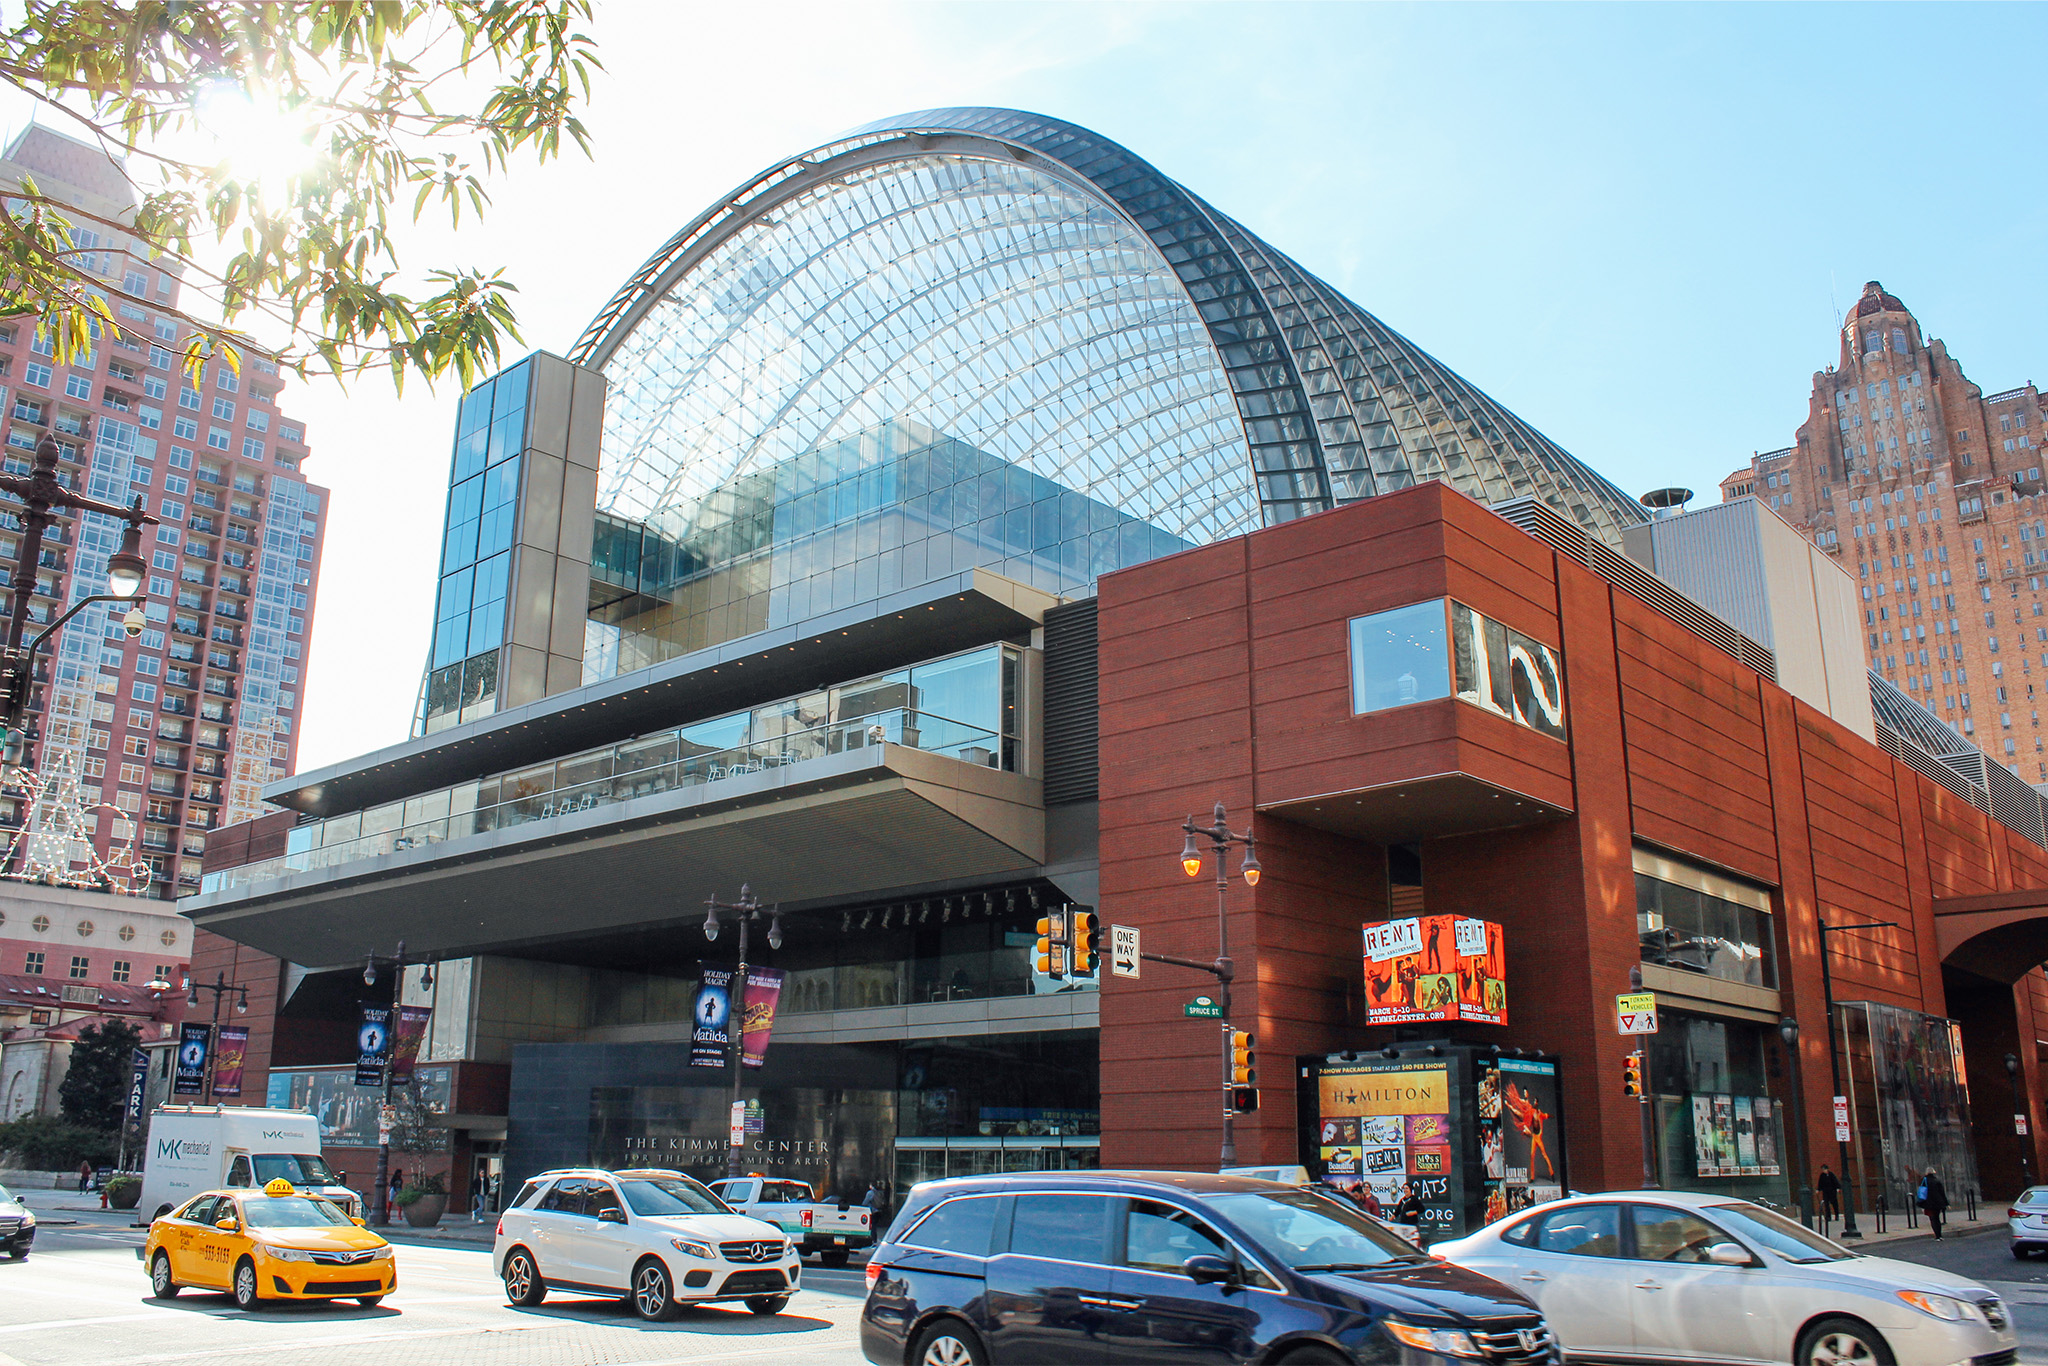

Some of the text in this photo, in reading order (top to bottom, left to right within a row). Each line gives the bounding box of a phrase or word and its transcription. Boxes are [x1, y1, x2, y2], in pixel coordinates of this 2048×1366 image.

[1117, 931, 1134, 943] ONE
[1367, 923, 1415, 950] RENT
[1457, 924, 1483, 943] RENT
[1117, 944, 1135, 956] WAY
[704, 970, 732, 979] HOLIDAY
[1189, 1007, 1210, 1015] SPRUCE
[1368, 1007, 1391, 1016] MARCH
[1460, 1003, 1473, 1011] MARCH
[1369, 1012, 1445, 1023] KIMMELCENTER.ORG
[1460, 1011, 1500, 1023] KIMMELCENTER.ORG
[129, 1073, 143, 1117] PARK
[263, 1131, 283, 1139] MK
[157, 1138, 211, 1160] MK mechanical
[625, 1138, 829, 1152] THE KIMME CENTER
[624, 1153, 830, 1165] FOR THE PERFOMING ARTS
[1368, 1151, 1400, 1166] RENT
[1328, 1161, 1354, 1169] Beautiful
[180, 1230, 194, 1239] Yellow
